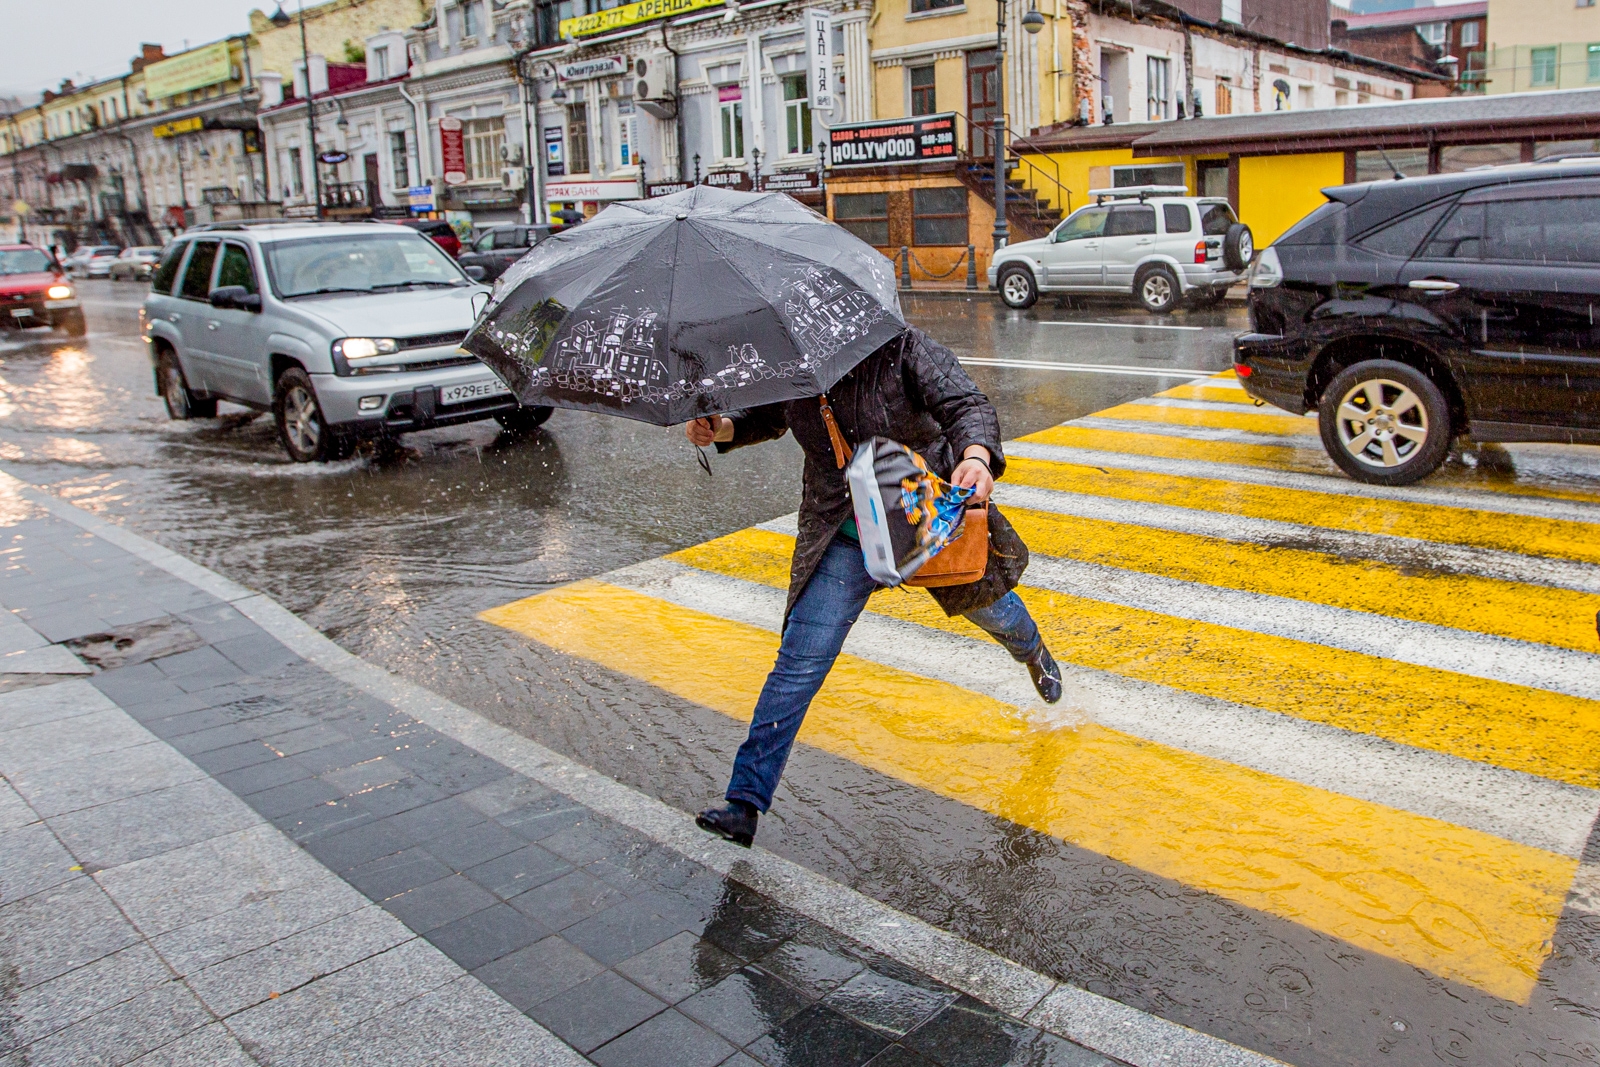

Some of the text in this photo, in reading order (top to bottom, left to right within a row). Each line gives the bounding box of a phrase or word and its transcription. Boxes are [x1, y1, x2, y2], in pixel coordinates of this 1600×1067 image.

[578, 10, 624, 32] 2222-777
[636, 0, 693, 18] АРЕНДА
[566, 61, 614, 77] Юнитрэвэл
[832, 138, 916, 163] HOLLYWOOD
[707, 172, 742, 185] ЦАП-ЛЯ
[571, 186, 600, 196] БАНК
[650, 184, 688, 196] РЕСТОРАН
